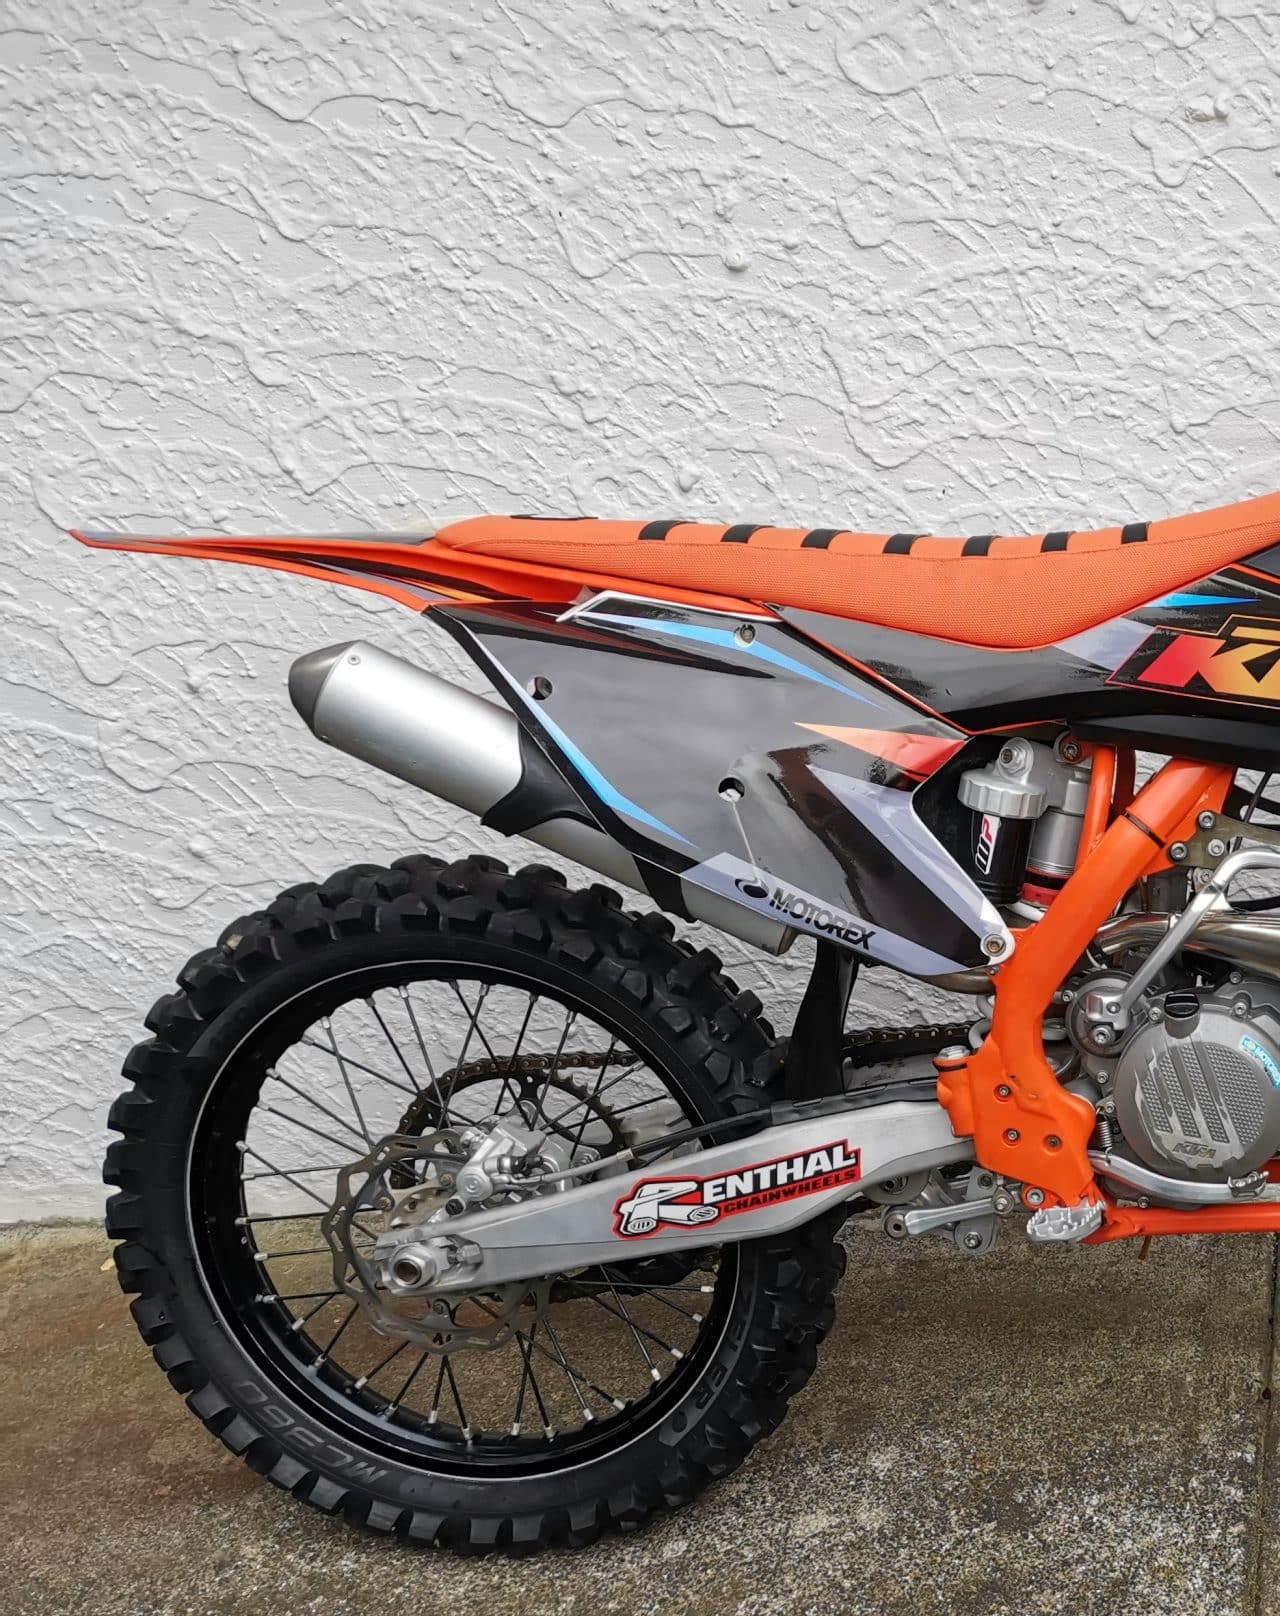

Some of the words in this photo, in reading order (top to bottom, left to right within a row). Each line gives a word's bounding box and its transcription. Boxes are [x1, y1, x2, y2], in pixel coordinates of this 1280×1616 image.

[769, 887, 876, 950] MOTOREX
[724, 1170, 857, 1213] CHAINWHEELS
[233, 1380, 389, 1484] MC360
